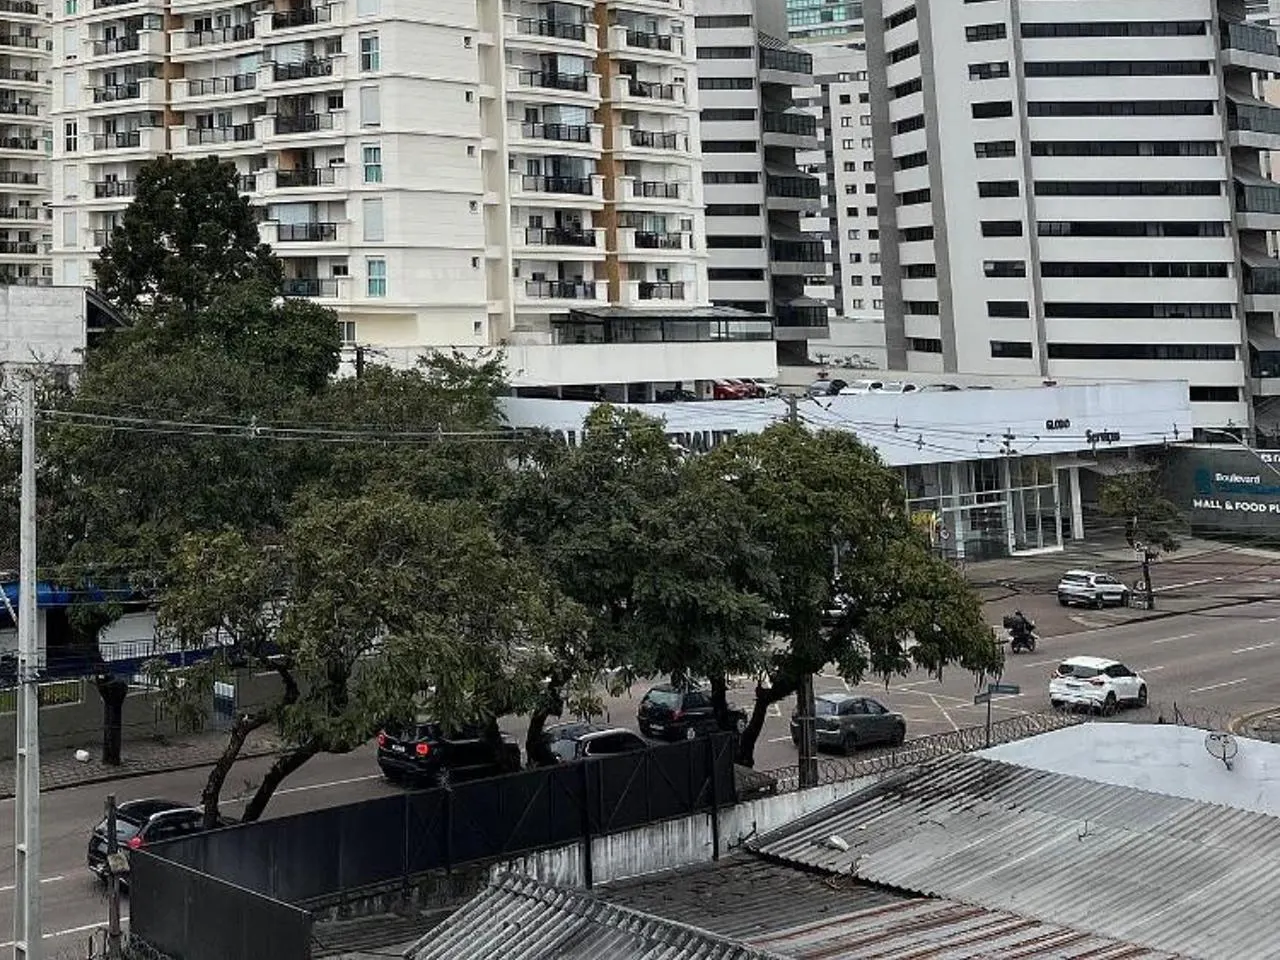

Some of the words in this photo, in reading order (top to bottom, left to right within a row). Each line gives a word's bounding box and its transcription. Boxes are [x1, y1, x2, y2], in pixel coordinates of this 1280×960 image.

[1214, 472, 1261, 484] Boulevard
[1225, 501, 1233, 511] &
[1235, 502, 1267, 512] FOOD
